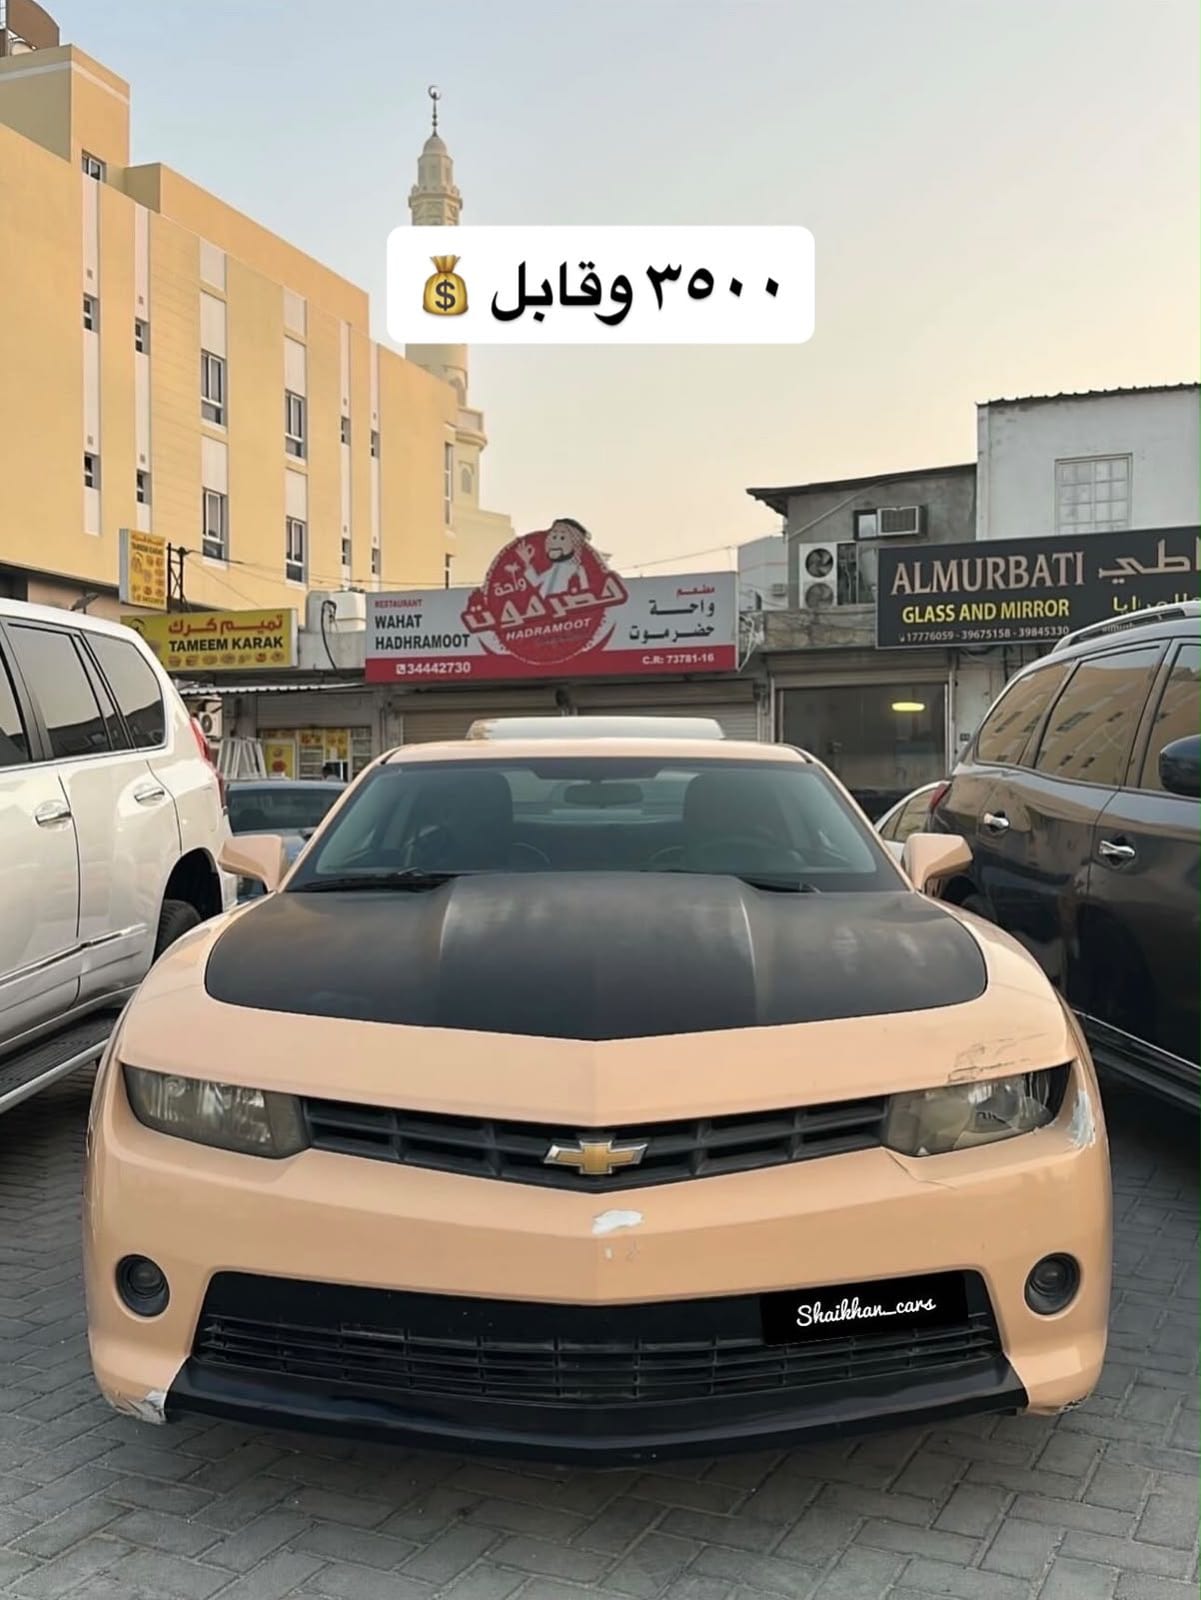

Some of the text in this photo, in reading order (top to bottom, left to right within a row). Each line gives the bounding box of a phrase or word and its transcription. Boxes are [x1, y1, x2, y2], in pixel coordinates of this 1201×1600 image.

[890, 551, 1085, 595] ALMURBATI
[648, 599, 716, 618] واحة
[902, 599, 1070, 623] GLASS AND MIRROR
[168, 614, 283, 636] تميم كرك
[375, 614, 423, 629] WAHAT
[506, 617, 592, 641] HADRAMOOT
[168, 636, 284, 652] TAMEEM KARAK
[375, 634, 470, 650] HADHRAMOOT
[629, 623, 716, 645] حضرموت
[407, 661, 471, 675] 34442730
